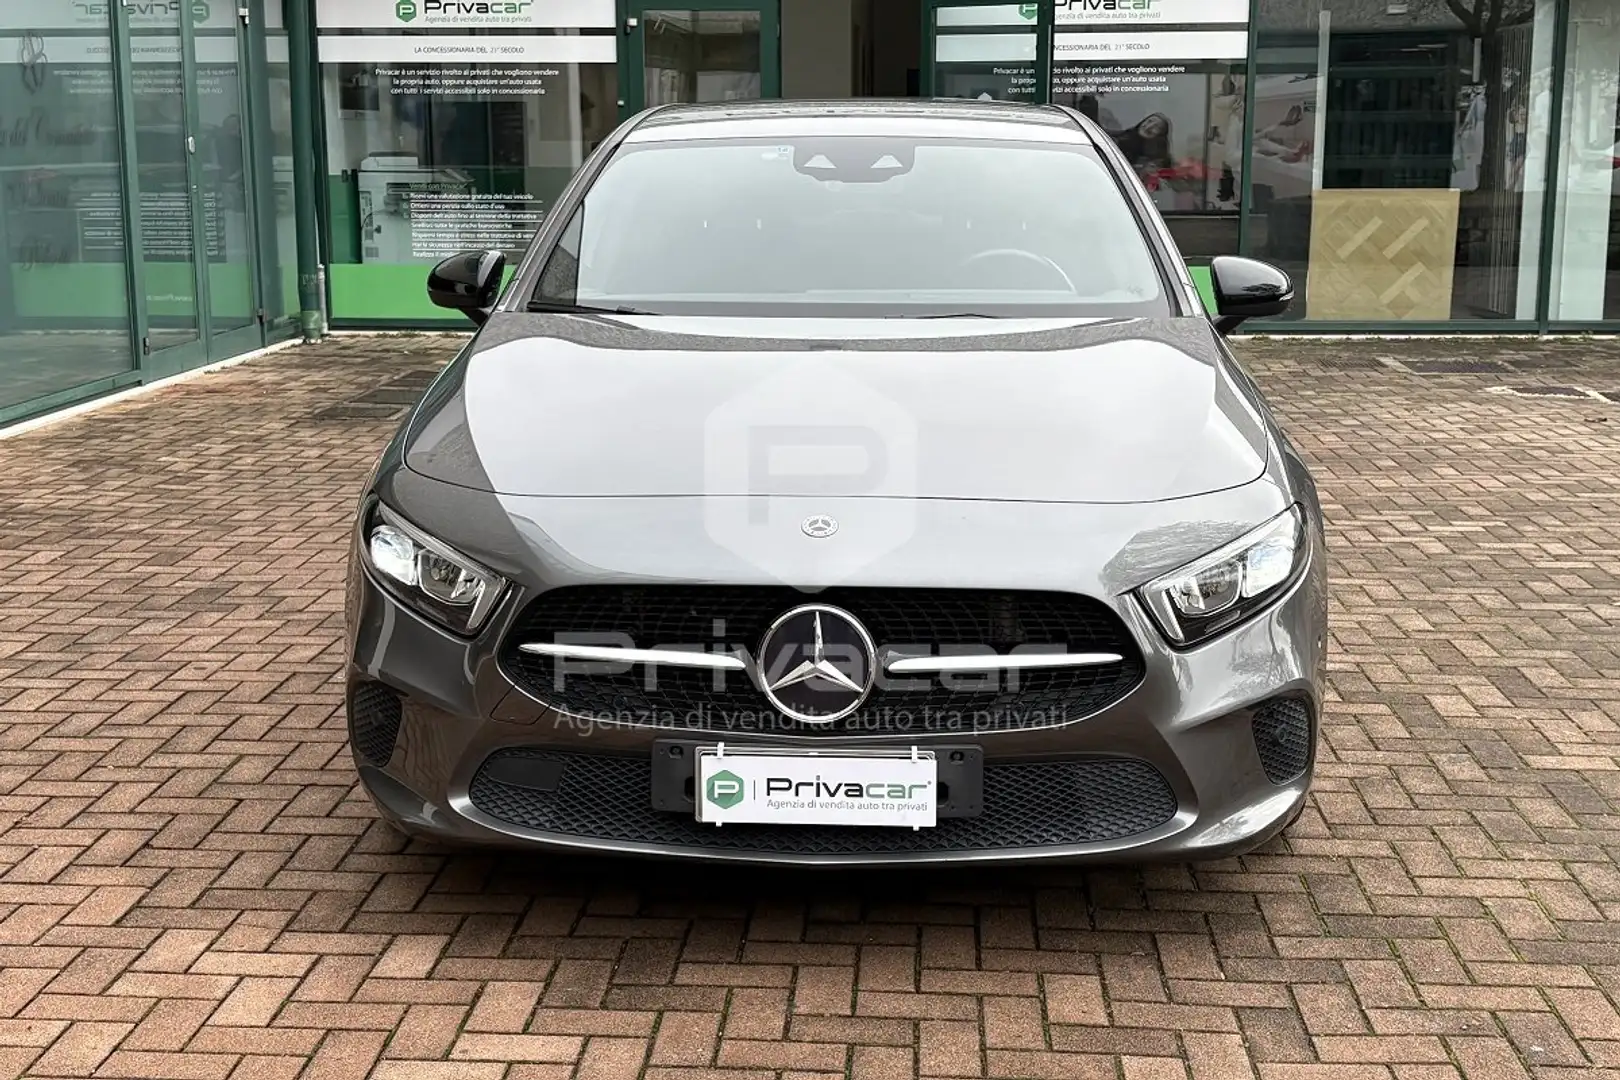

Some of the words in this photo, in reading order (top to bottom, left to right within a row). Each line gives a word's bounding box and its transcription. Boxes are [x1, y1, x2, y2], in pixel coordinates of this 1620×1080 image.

[425, 16, 450, 24] Agenzia
[1139, 11, 1161, 20] privati
[375, 68, 401, 76] Privacar
[441, 68, 463, 76] rivolto
[470, 68, 491, 77] privati
[491, 68, 503, 76] che
[503, 68, 533, 77] vogliono
[533, 68, 559, 76] vendere
[993, 67, 1019, 75] Privacar
[1062, 66, 1084, 74] rivolto
[1085, 66, 1091, 74] ai
[1092, 66, 1114, 75] privati
[1127, 65, 1157, 74] vogliono
[1158, 65, 1186, 73] vendere
[400, 78, 424, 87] propria
[441, 79, 466, 87] oppure
[466, 78, 499, 87] acquistare
[1061, 78, 1086, 86] oppure
[1086, 76, 1121, 85] acquistare
[1148, 75, 1167, 83] usata
[423, 87, 444, 95] servizi
[477, 87, 491, 95] solo
[1064, 85, 1098, 93] accessibili
[1098, 85, 1112, 93] solo
[1112, 85, 1120, 93] in
[1120, 84, 1169, 93] concessionaria
[714, 780, 739, 799] P
[766, 775, 928, 799] Privacar
[766, 798, 805, 812] Agenzia
[808, 798, 817, 809] di
[819, 799, 855, 810] vendita
[857, 800, 879, 810] auto
[881, 801, 895, 811] tra
[897, 801, 928, 813] privati
